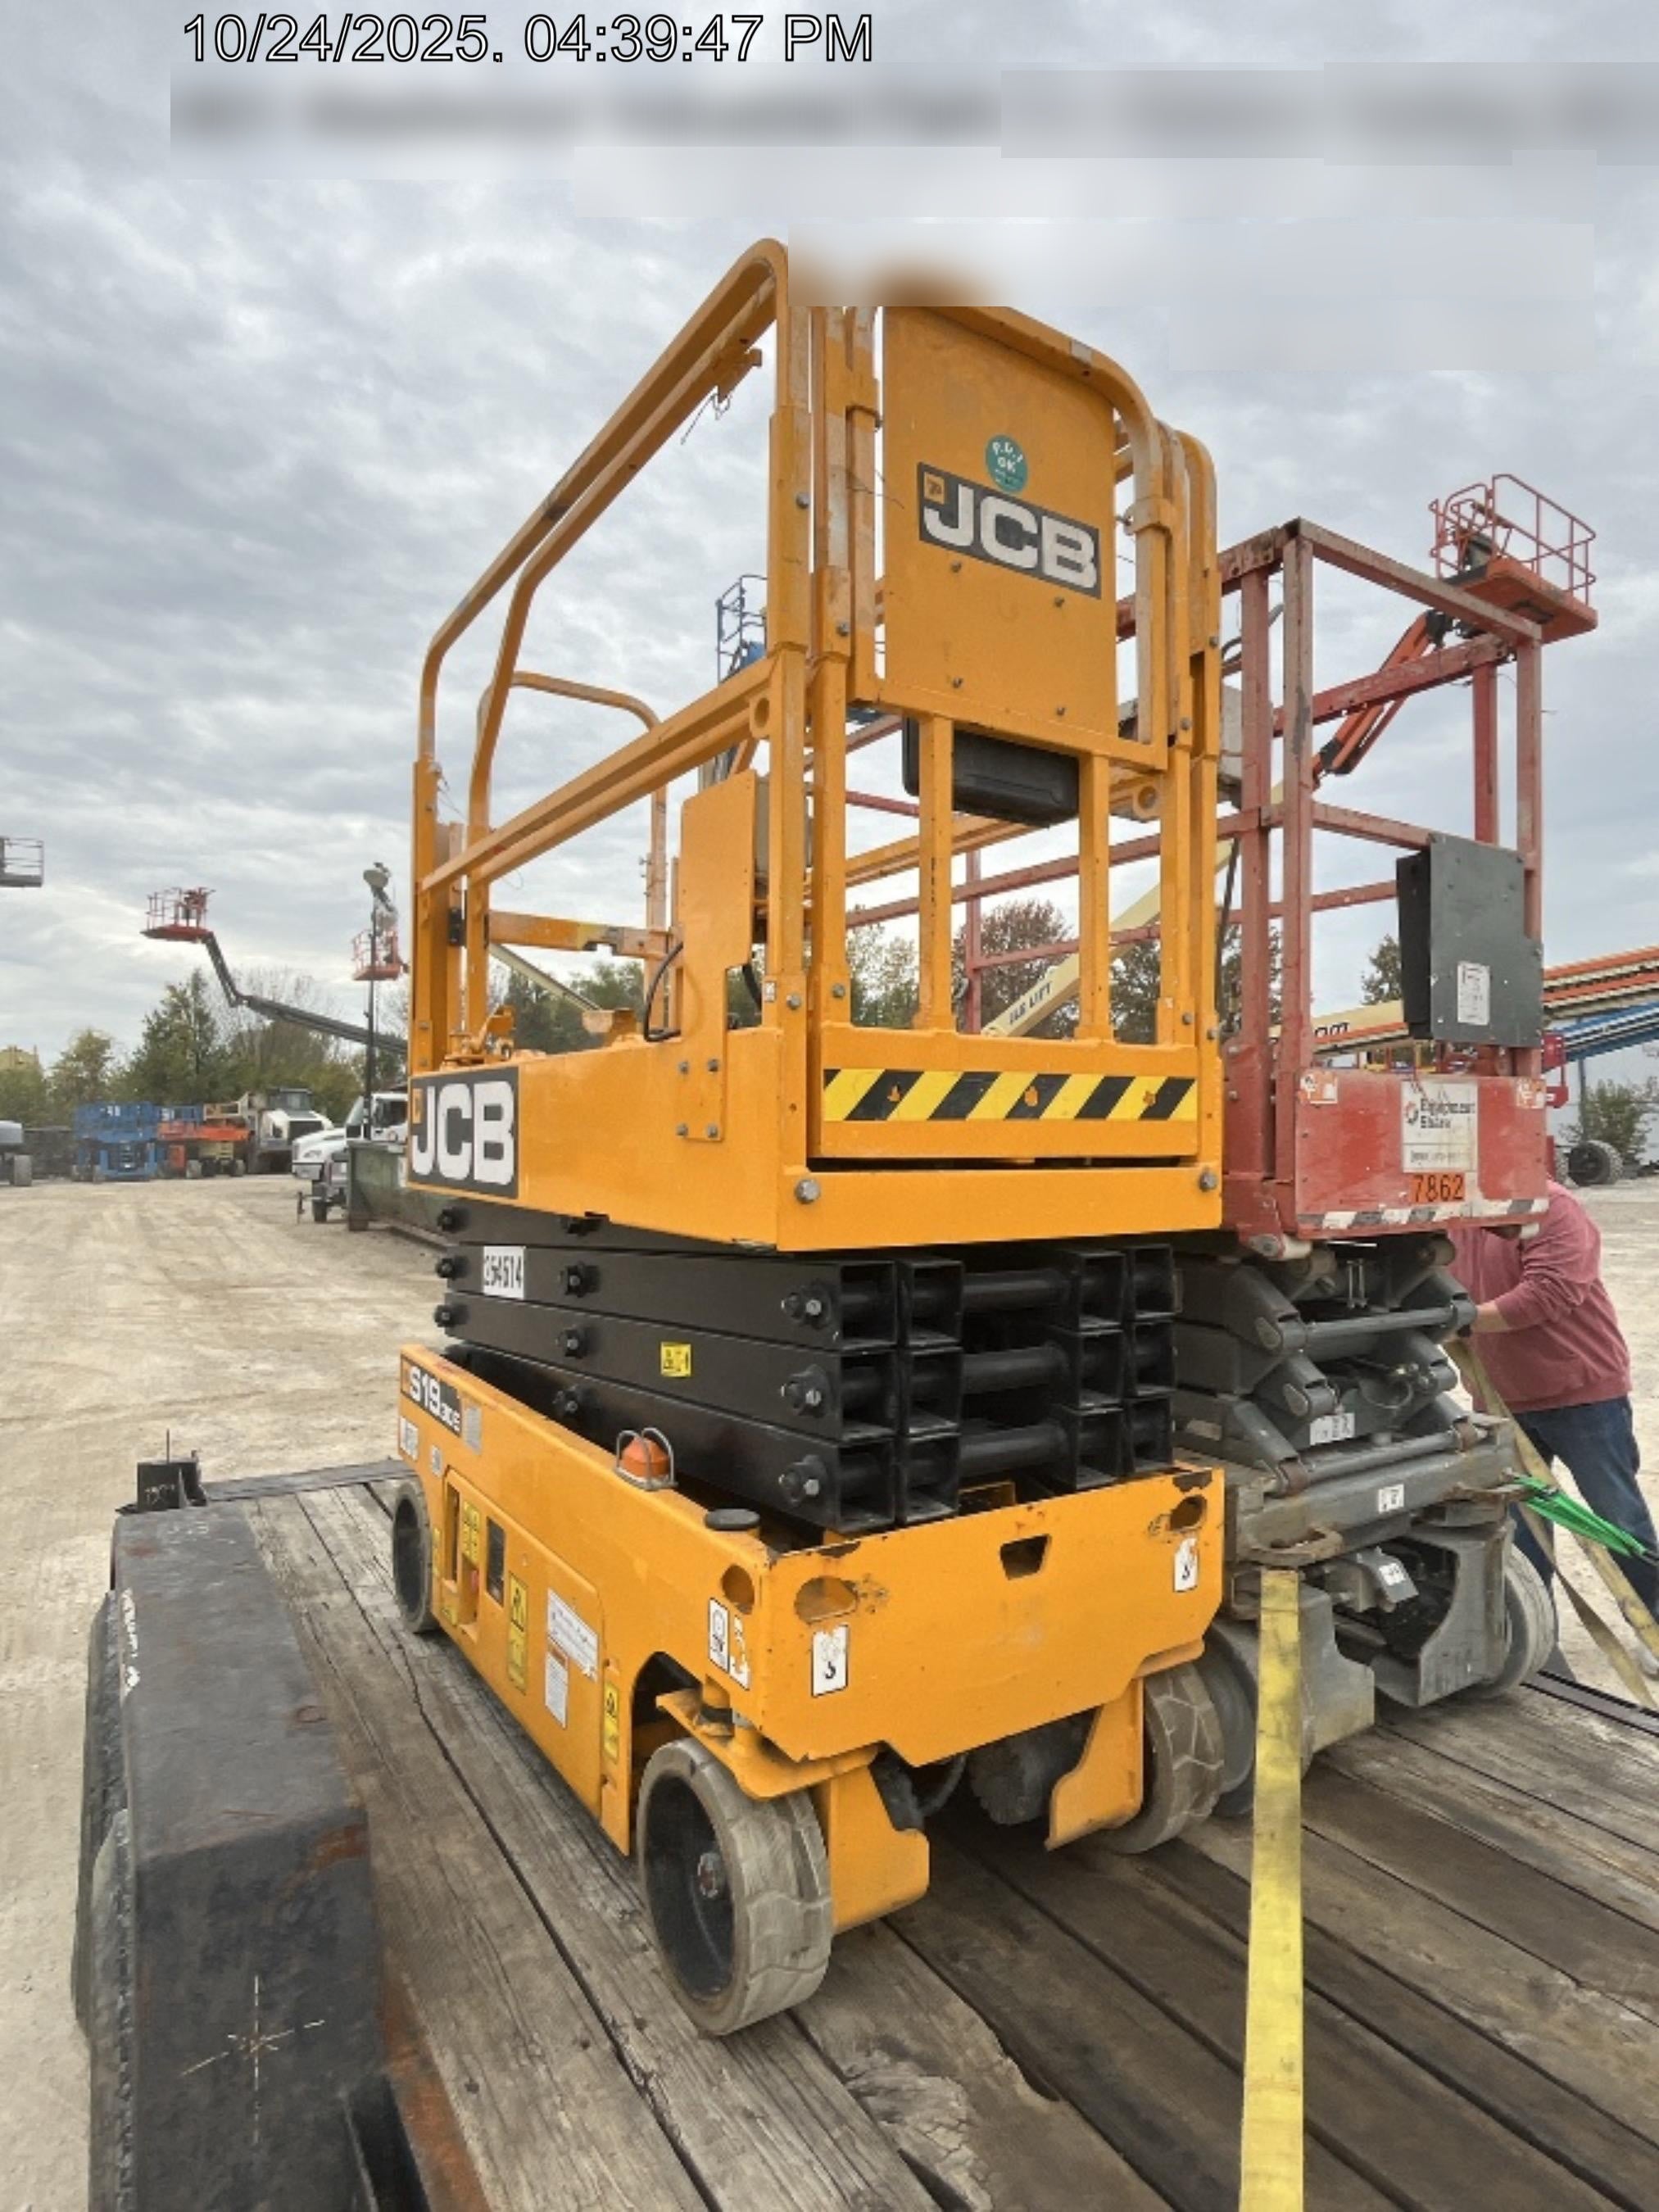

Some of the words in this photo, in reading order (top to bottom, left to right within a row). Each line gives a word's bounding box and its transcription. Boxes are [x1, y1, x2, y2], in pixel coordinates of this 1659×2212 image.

[923, 483, 1097, 589] JCB
[412, 1081, 514, 1185] JCB
[1412, 1174, 1464, 1203] 7862
